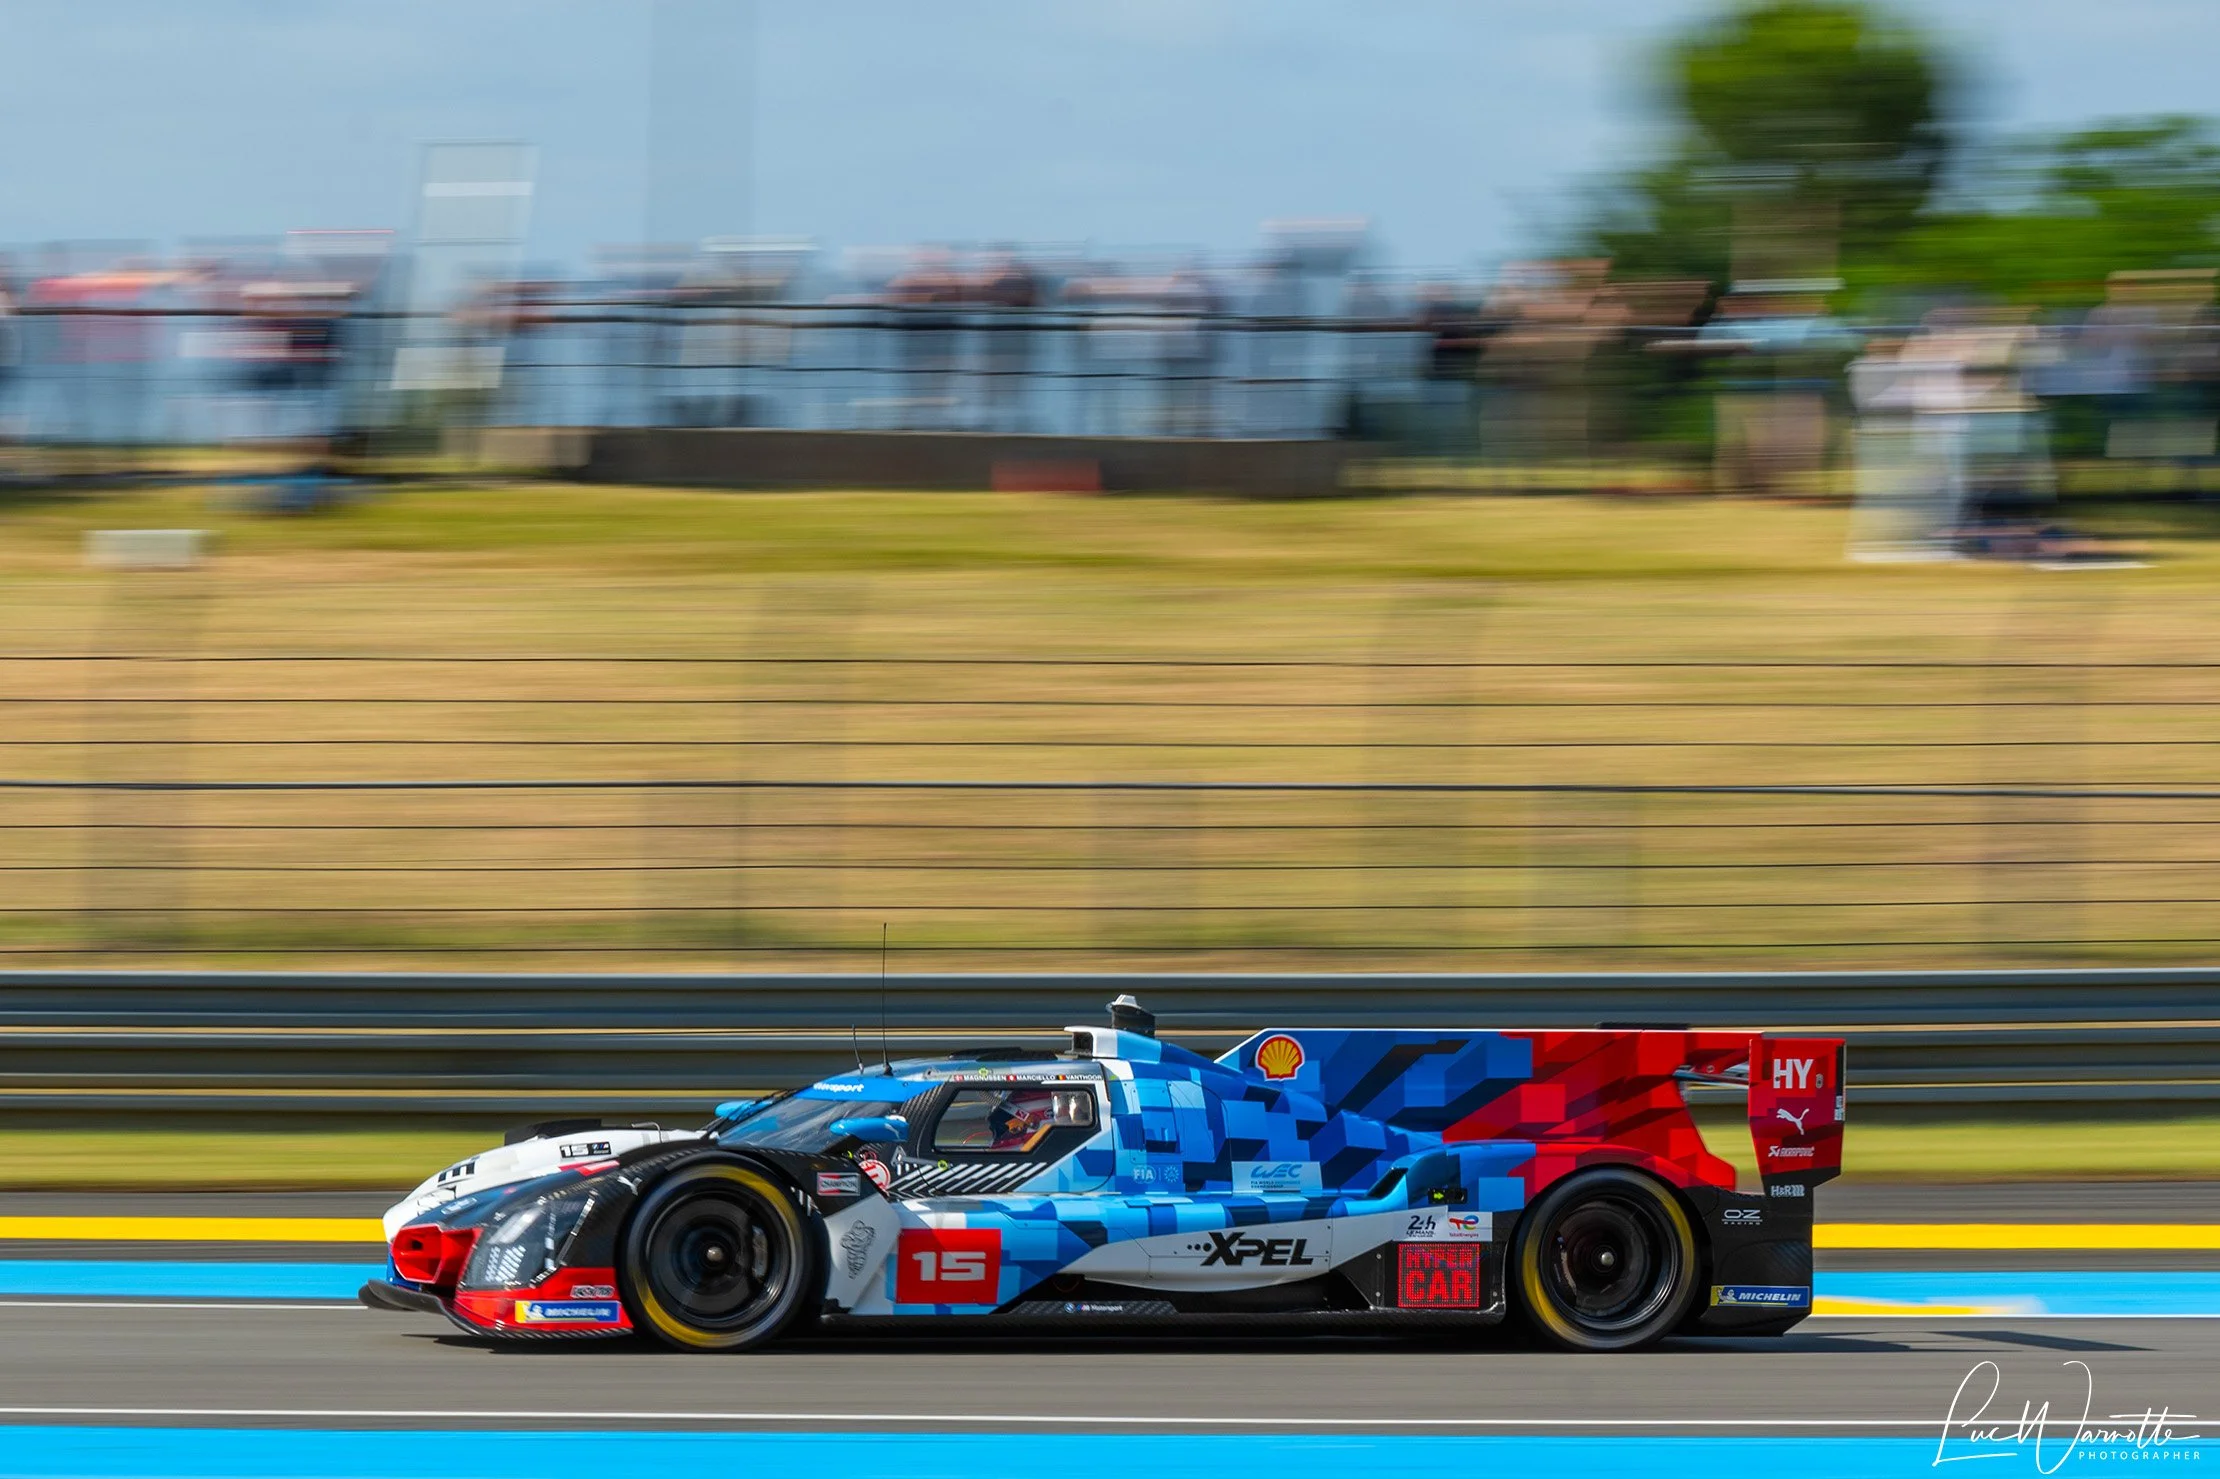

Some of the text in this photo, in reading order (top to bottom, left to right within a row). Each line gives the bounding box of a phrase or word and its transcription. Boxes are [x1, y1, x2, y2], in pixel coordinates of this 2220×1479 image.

[1773, 1059, 1814, 1089] HY
[1133, 1168, 1154, 1180] FIA
[1251, 1163, 1303, 1178] WEC
[1201, 1232, 1314, 1266] XPEL
[1406, 1249, 1473, 1268] HYPER
[912, 1251, 986, 1282] 15
[1406, 1270, 1473, 1300] CAR
[1738, 1292, 1801, 1301] MICHELIN
